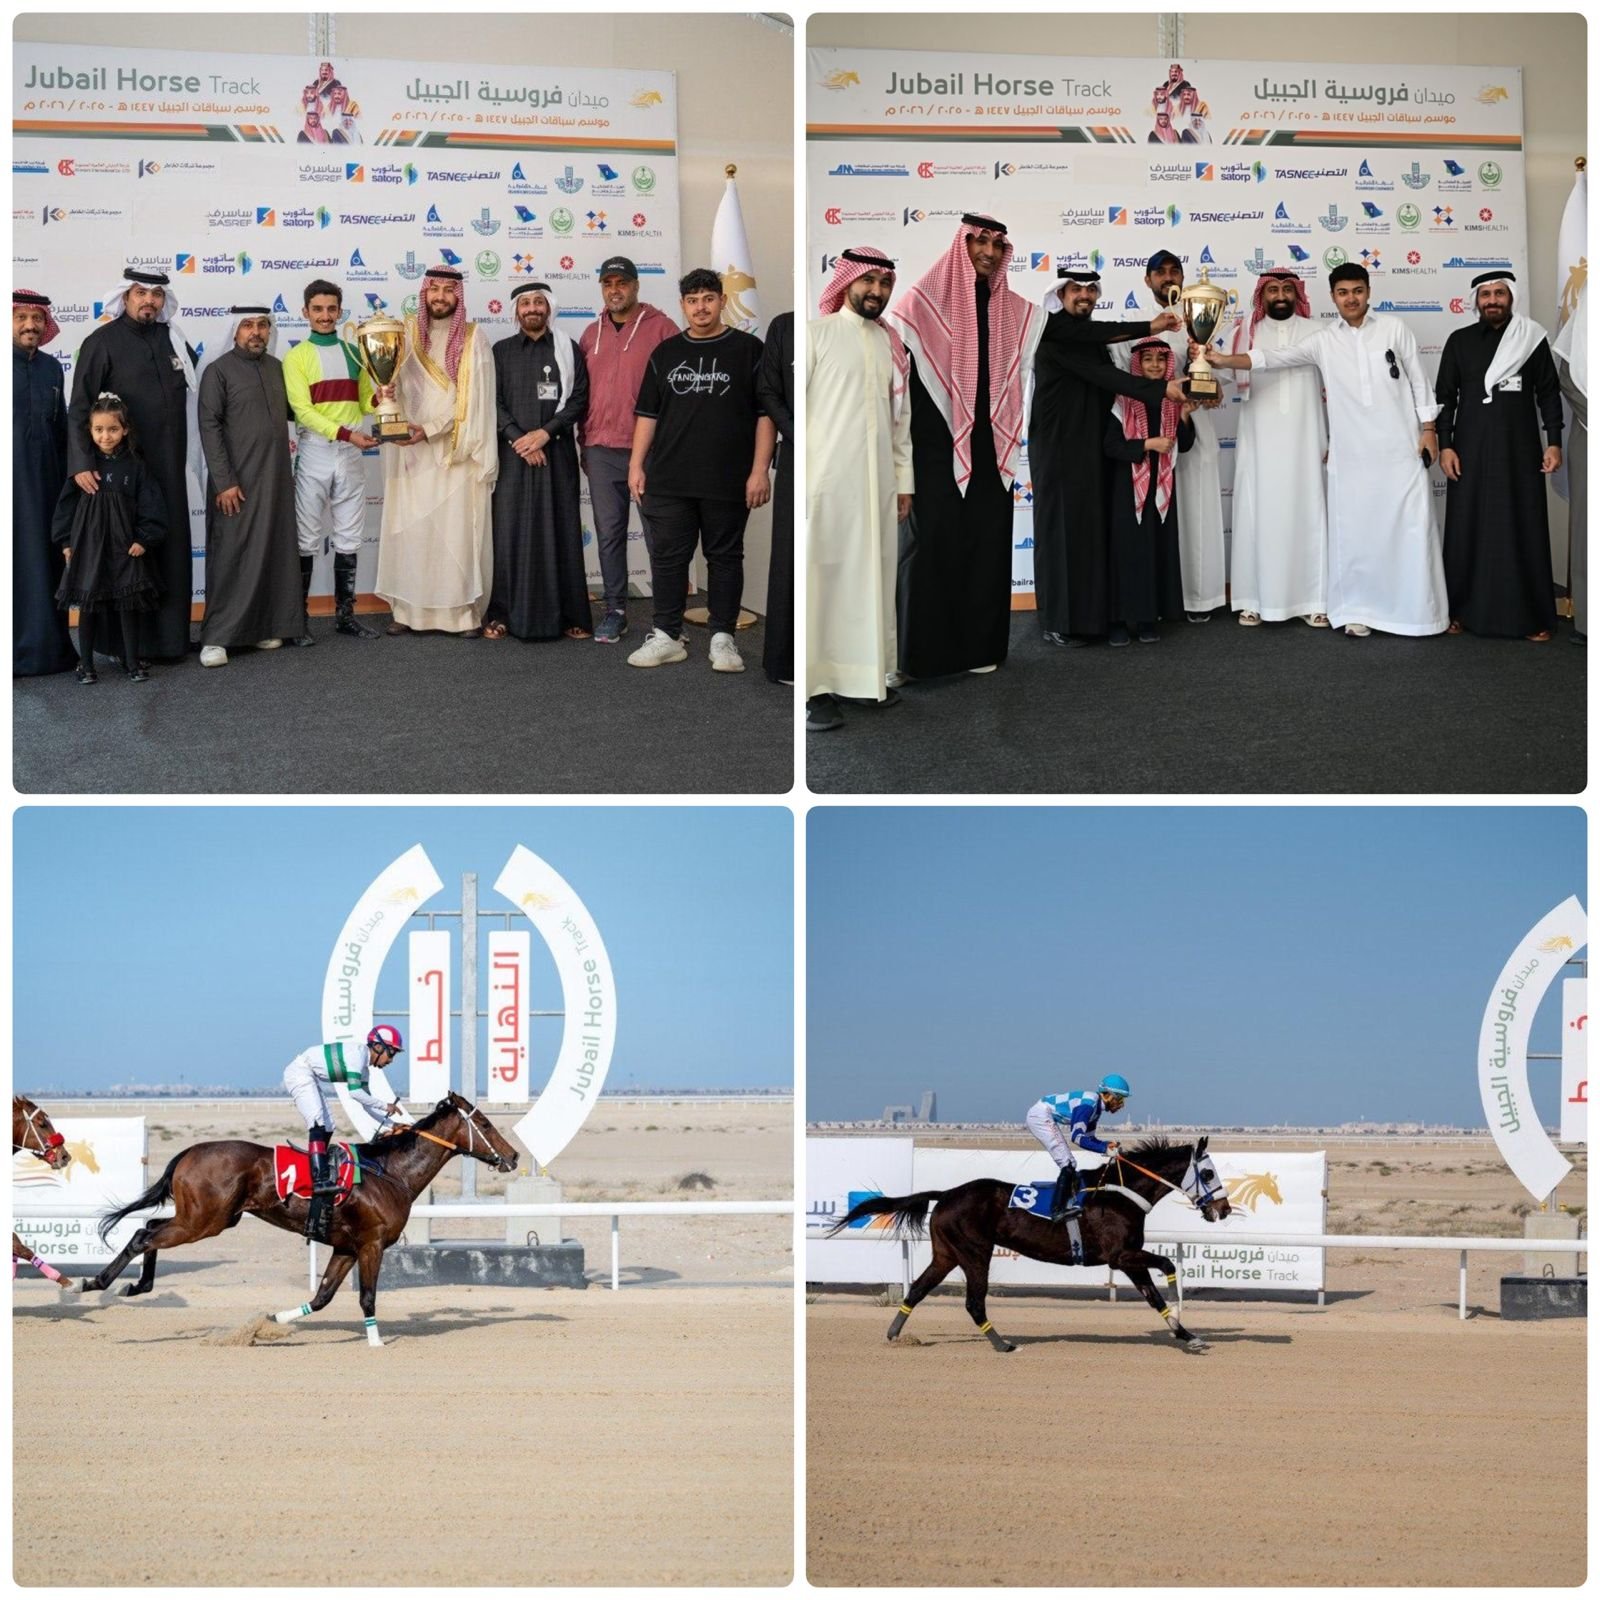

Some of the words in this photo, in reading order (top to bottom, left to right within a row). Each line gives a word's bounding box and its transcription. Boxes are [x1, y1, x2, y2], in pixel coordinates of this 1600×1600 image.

[24, 65, 106, 90] Jubail
[117, 68, 201, 93] Horse
[209, 75, 261, 96] Track
[886, 72, 963, 95] Jubail
[974, 74, 1054, 96] Horse
[1061, 79, 1112, 97] Track
[406, 77, 469, 104] الجبيل
[478, 80, 563, 108] فروسية
[1253, 78, 1316, 103] الجبيل
[1324, 79, 1409, 106] فروسية
[1414, 87, 1456, 106] ميدان
[568, 91, 610, 109] ميدان
[159, 101, 190, 113] الجبيل
[194, 101, 232, 113] سباقات
[234, 103, 270, 115] موسم
[1013, 104, 1043, 116] الجبيل
[1047, 105, 1083, 116] سباقات
[1085, 106, 1121, 117] موسم
[511, 115, 538, 126] الجبيل
[541, 115, 576, 126] سباقات
[1357, 111, 1384, 122] الجبيل
[1387, 112, 1421, 123] سباقات
[1422, 114, 1456, 124] موسم
[578, 118, 610, 129] موسم
[298, 163, 342, 174] ساسرف
[1149, 163, 1191, 173] ساسرف
[299, 174, 342, 182] SASREF
[371, 174, 402, 185] satorp
[1220, 172, 1251, 183] satorp
[207, 207, 252, 219] ساسرف
[1061, 207, 1104, 217] ساسرف
[209, 219, 252, 227] SASREF
[282, 218, 315, 229] satorp
[1062, 218, 1104, 226] SASREF
[1134, 216, 1165, 227] satorp
[126, 255, 172, 265] ساسرف
[203, 263, 235, 274] satorp
[1391, 267, 1437, 275] KIMSHEALTH
[53, 314, 89, 323] ASREF
[562, 914, 589, 957] Track
[332, 940, 362, 1027] فروسية
[582, 958, 603, 1027] Horse
[417, 969, 444, 1065] خط
[492, 951, 526, 1083] النهاية
[1489, 987, 1519, 1069] فروسية
[570, 1033, 602, 1101] Jubail
[1490, 1074, 1522, 1135] الجبيل
[280, 1164, 297, 1195] 1
[1012, 1186, 1039, 1210] 3
[15, 1219, 81, 1238] فروسية
[24, 1239, 79, 1254] Horse
[1202, 1245, 1265, 1263] فروسية
[1211, 1265, 1262, 1280] Horse
[1267, 1270, 1299, 1281] Track
